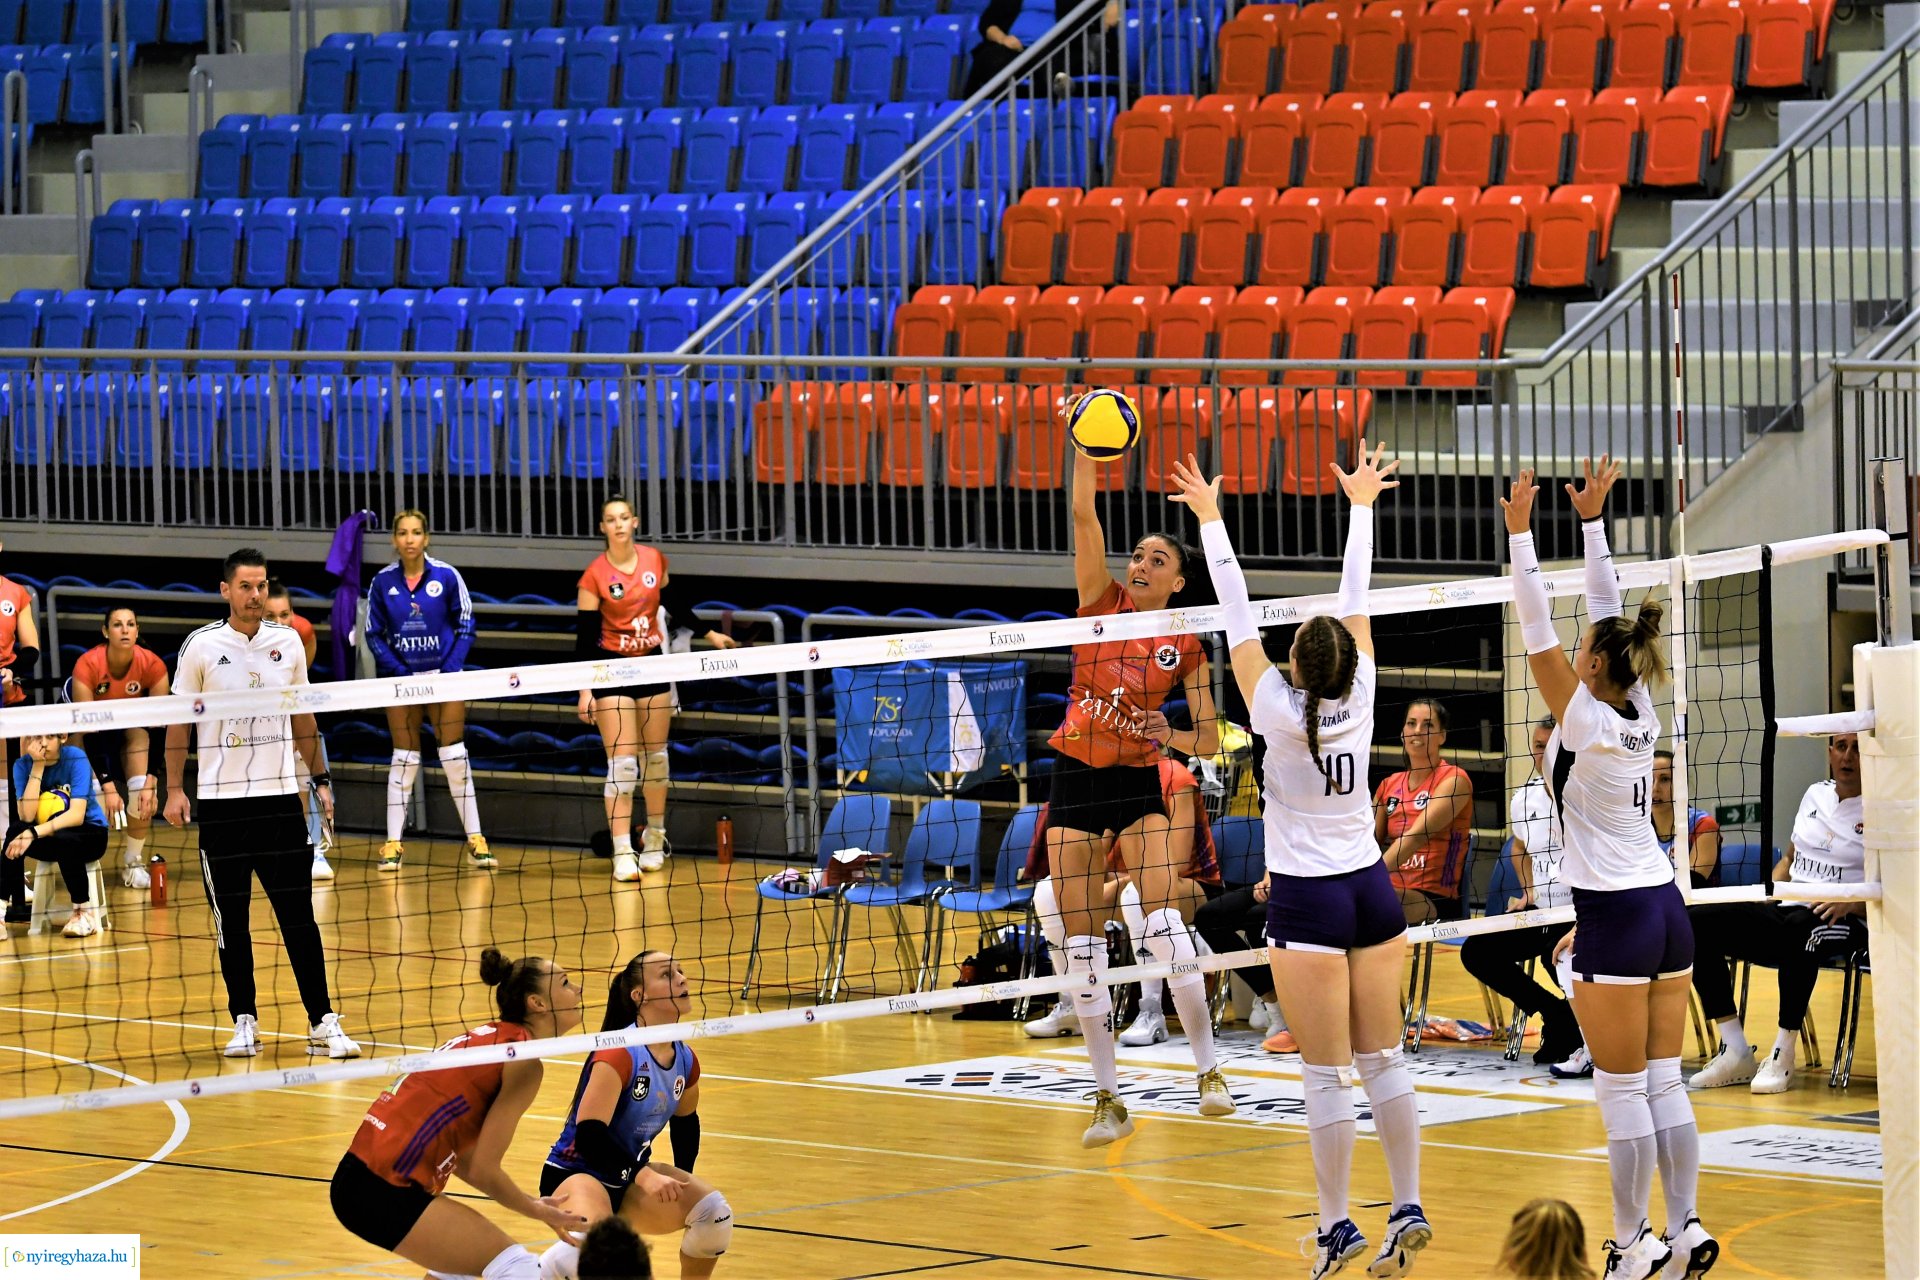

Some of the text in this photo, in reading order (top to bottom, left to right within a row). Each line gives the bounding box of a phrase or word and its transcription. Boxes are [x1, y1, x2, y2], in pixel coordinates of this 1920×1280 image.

[1262, 605, 1297, 620] FATUM
[619, 634, 662, 651] FATUM
[989, 631, 1026, 646] FATUM
[700, 657, 739, 673] FATUM
[394, 682, 435, 699] FATUM
[1111, 687, 1125, 708] 1
[72, 708, 114, 725] FATUM
[1316, 709, 1350, 728] ZATMÁRI
[1325, 753, 1354, 796] 10
[1633, 776, 1646, 817] 4
[1794, 851, 1843, 880] FATUM
[1432, 926, 1459, 939] FATUM
[1171, 963, 1200, 974] FATUM
[889, 998, 919, 1011] FATUM
[594, 1036, 627, 1048] FATUM
[283, 1070, 318, 1085] FATUM
[637, 1140, 651, 1162] 7
